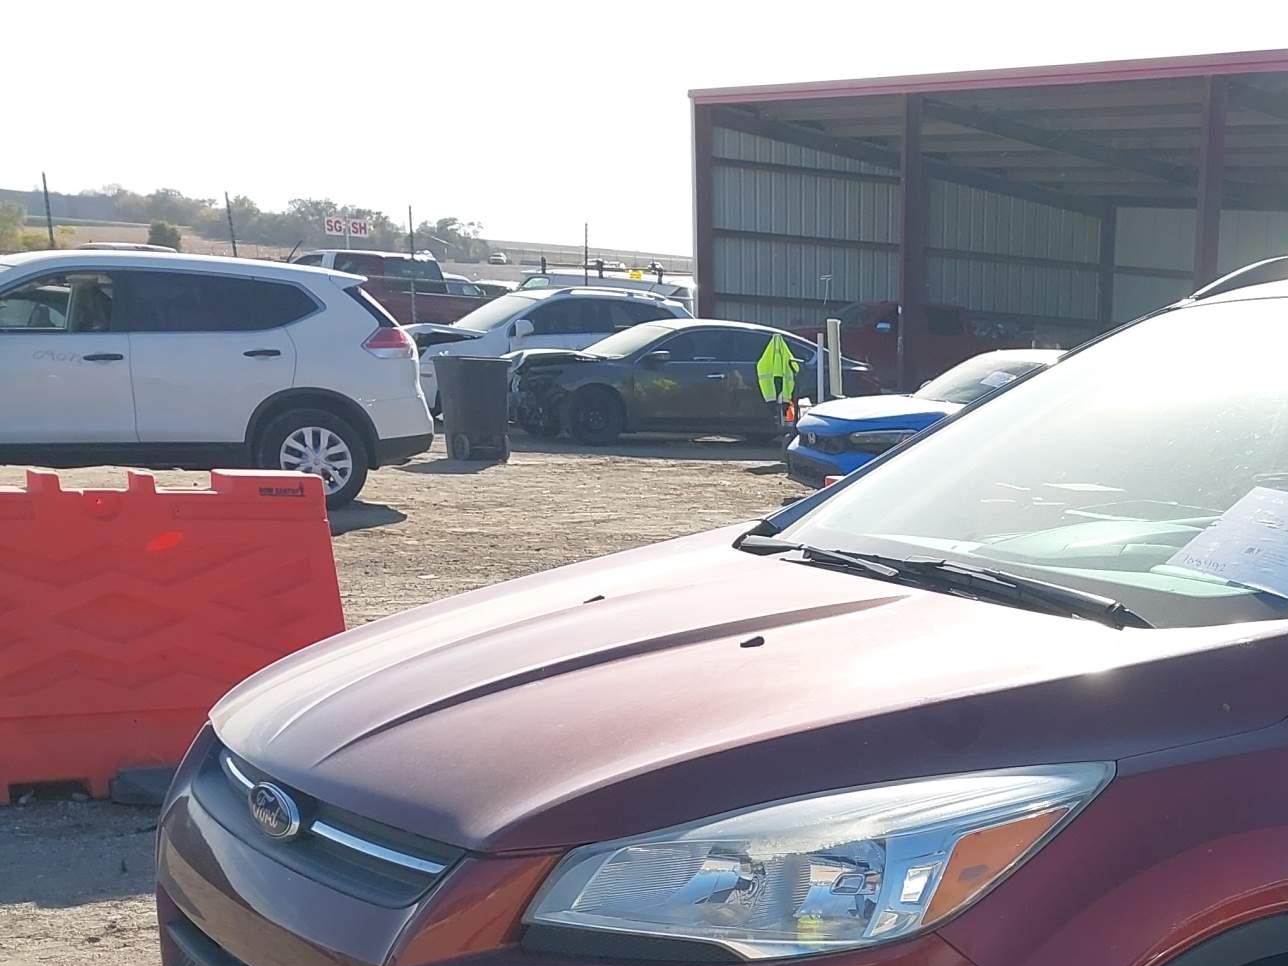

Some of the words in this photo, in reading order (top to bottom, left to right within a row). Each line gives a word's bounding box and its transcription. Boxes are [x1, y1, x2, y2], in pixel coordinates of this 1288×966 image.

[326, 219, 343, 232] SG
[351, 222, 367, 235] SH
[252, 789, 281, 829] Ford
